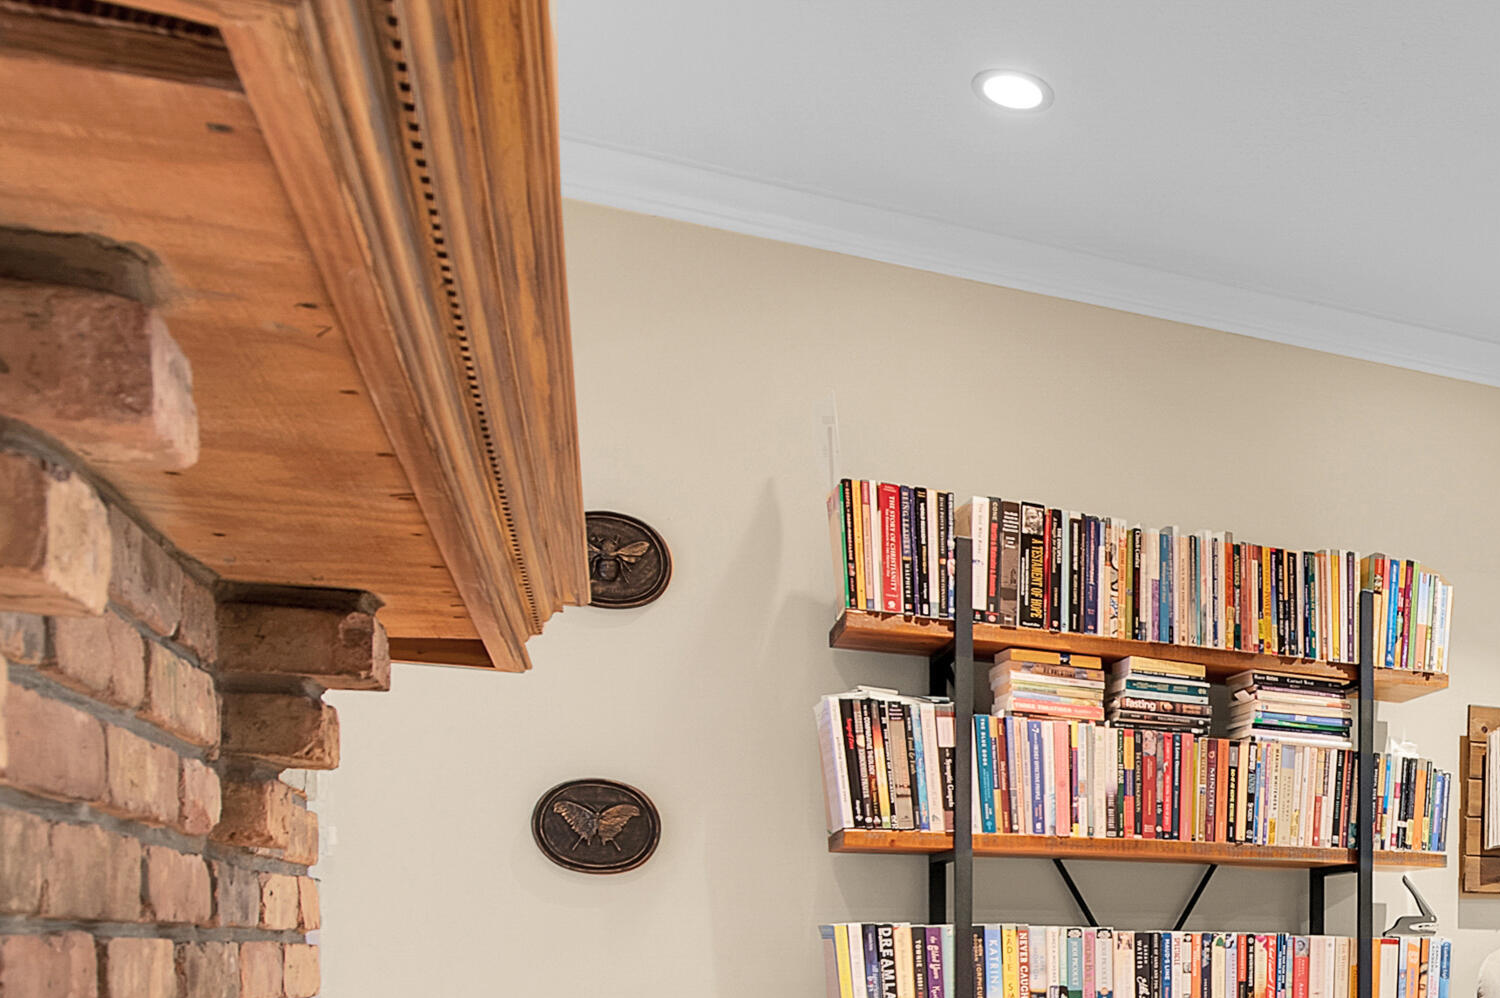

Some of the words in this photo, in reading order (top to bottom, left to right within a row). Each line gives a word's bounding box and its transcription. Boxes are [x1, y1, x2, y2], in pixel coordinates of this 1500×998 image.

[1031, 546, 1043, 587] TESTAMENT
[1031, 587, 1043, 596] OF
[1031, 598, 1043, 619] HOPE
[1126, 698, 1156, 711] fasting
[915, 939, 923, 967] TOWNIE
[1019, 933, 1027, 962] NEVER
[989, 940, 999, 993] KATRINA
